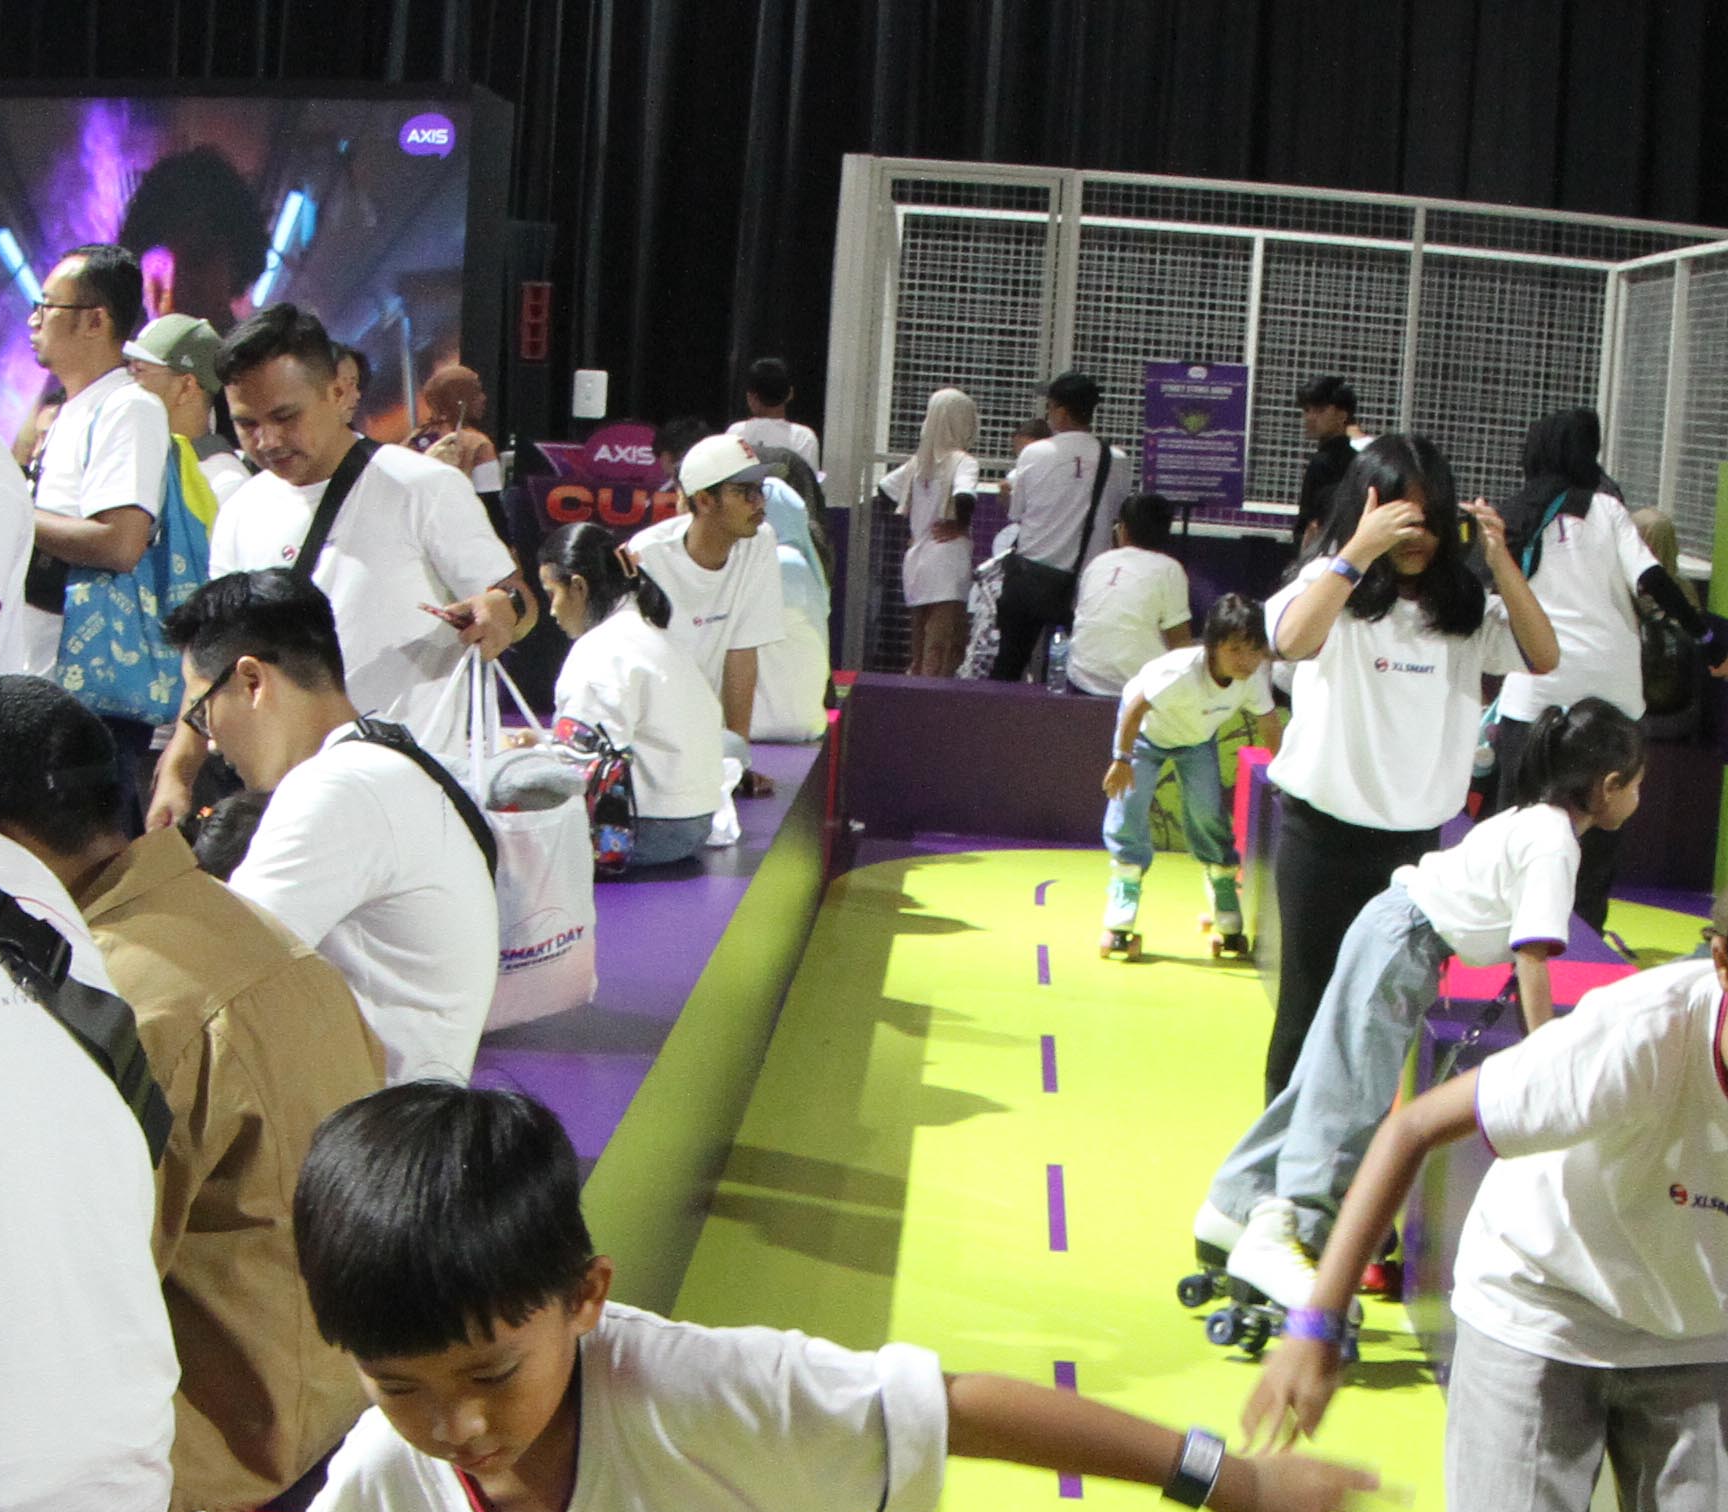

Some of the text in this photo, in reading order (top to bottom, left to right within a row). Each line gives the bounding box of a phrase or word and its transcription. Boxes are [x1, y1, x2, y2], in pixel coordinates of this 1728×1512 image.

[407, 129, 449, 145] AXIS
[593, 444, 656, 465] AXIS
[556, 925, 585, 948] DAY
